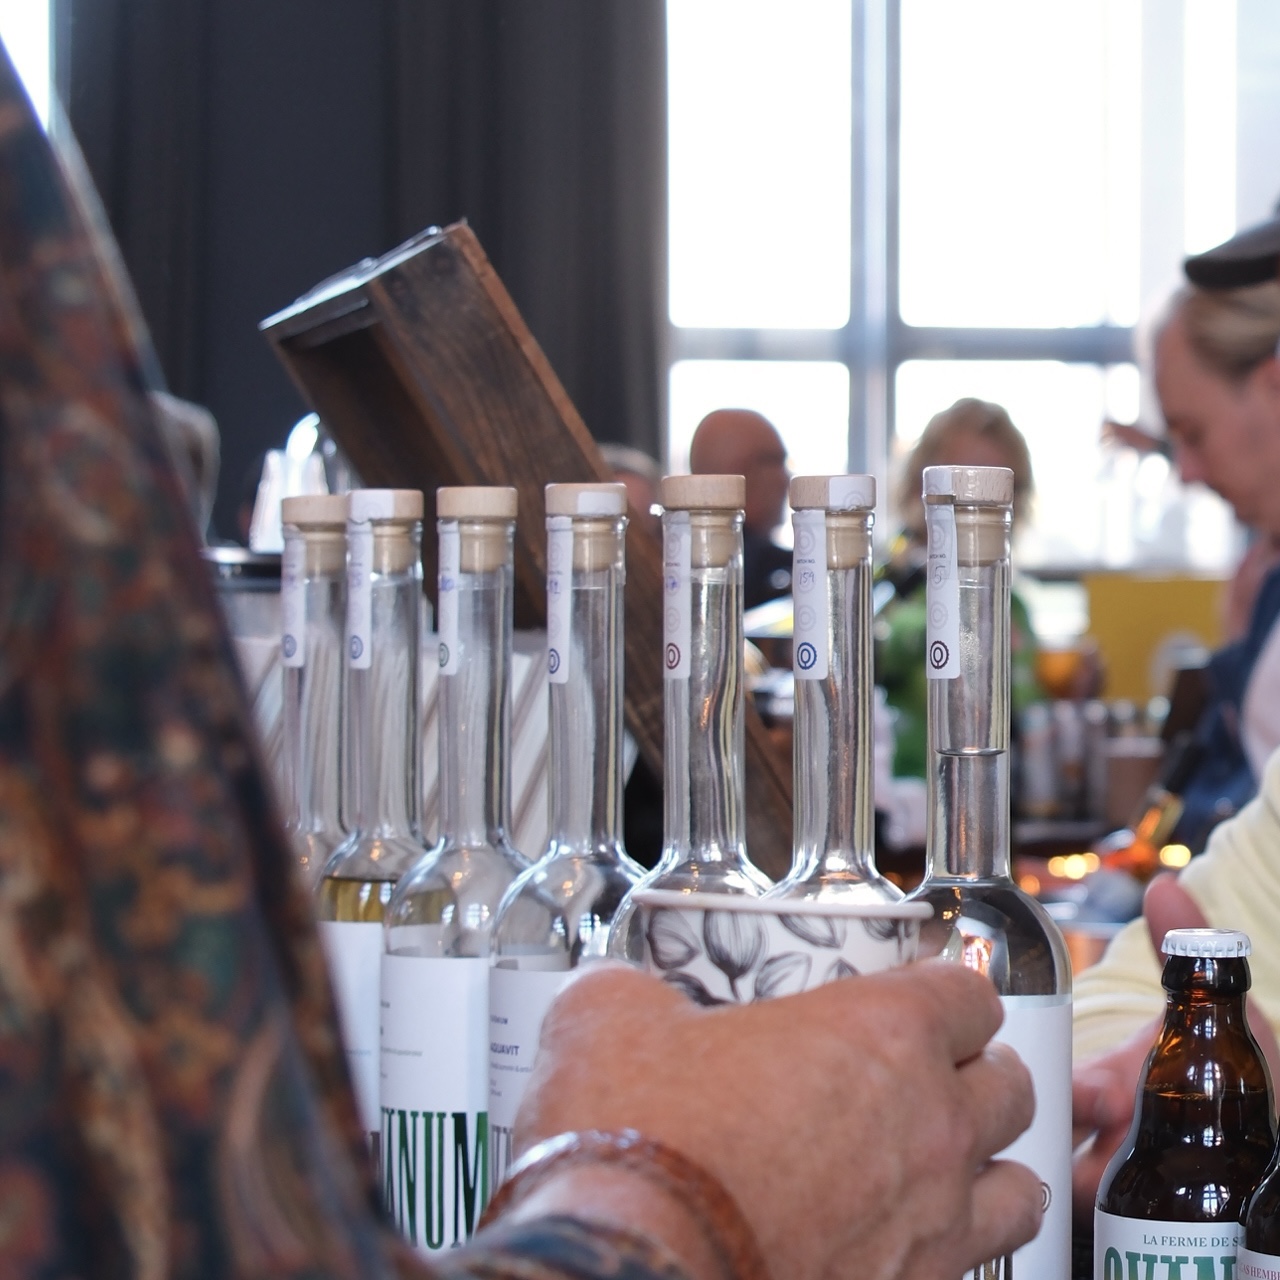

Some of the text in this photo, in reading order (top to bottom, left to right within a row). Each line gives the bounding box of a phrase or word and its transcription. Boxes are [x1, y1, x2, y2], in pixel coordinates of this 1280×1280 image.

[1143, 1234, 1158, 1246] LA
[1161, 1235, 1208, 1248] FERME
[1211, 1237, 1230, 1248] DE
